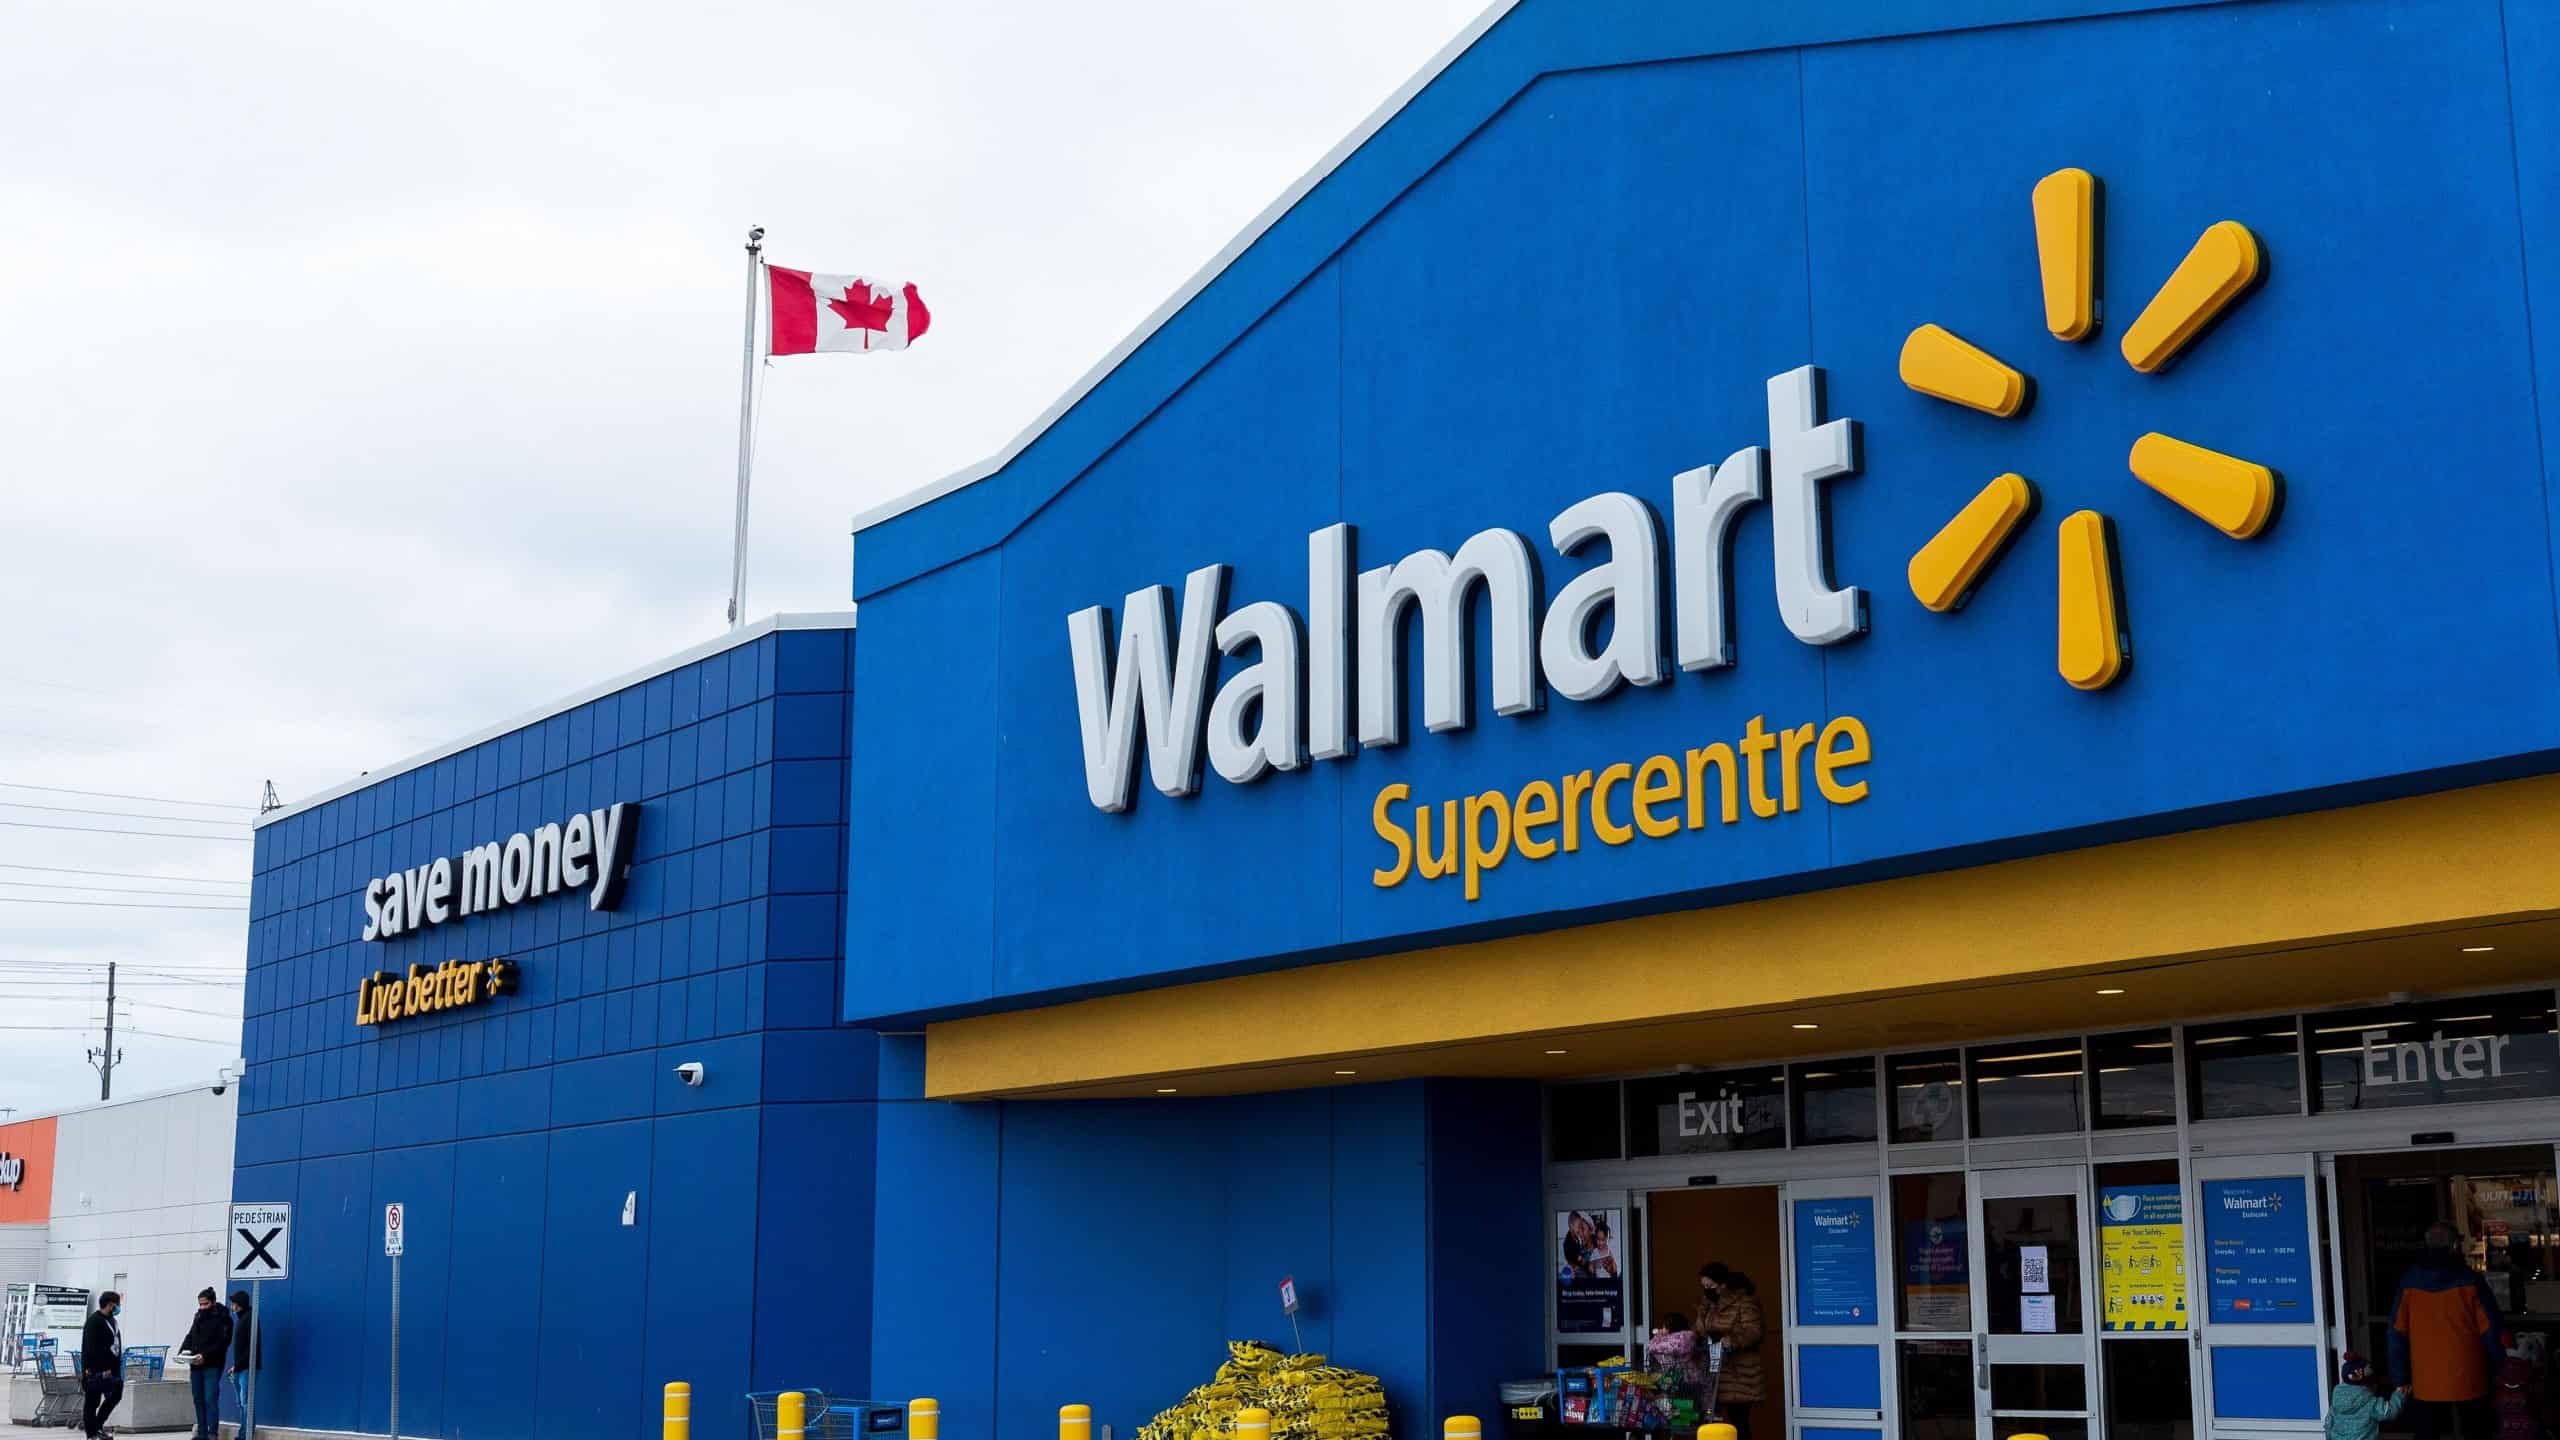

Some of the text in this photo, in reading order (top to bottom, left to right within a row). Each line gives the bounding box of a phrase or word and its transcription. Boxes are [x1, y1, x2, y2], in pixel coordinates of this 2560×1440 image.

[1068, 365, 1860, 813] Walmart
[1373, 714, 1870, 900] Supercentre
[362, 857, 451, 942] save
[356, 959, 483, 1025] Live better
[2362, 1030, 2510, 1086] Enter
[1679, 1088, 1743, 1137] Exit
[0, 1152, 21, 1191] kup
[234, 1212, 287, 1224] PEDESTRIAN
[1814, 1215, 1848, 1226] Walmart
[2223, 1197, 2267, 1209] Walmart
